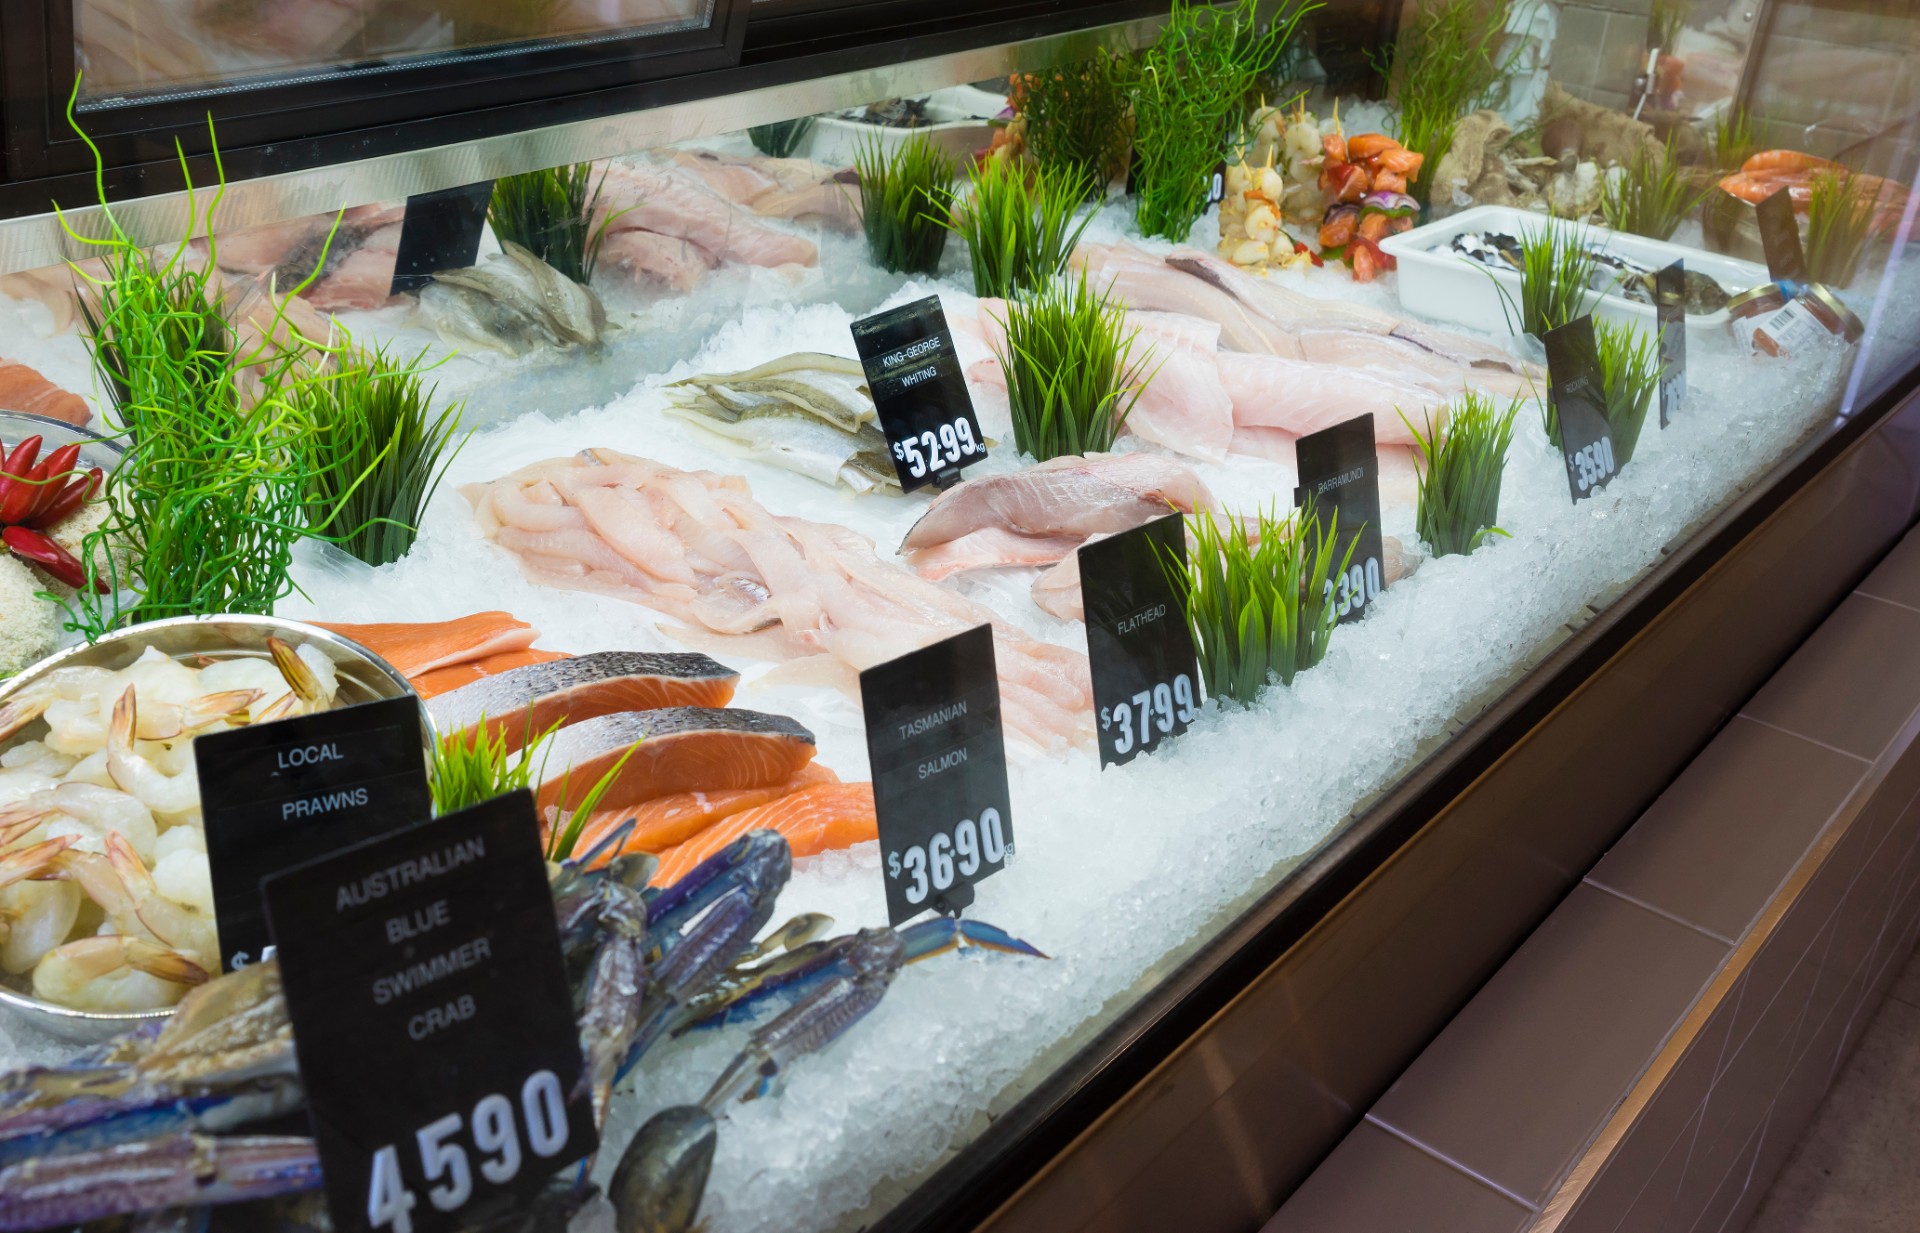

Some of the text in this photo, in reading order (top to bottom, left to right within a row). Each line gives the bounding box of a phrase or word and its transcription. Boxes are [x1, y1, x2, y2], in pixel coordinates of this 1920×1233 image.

[883, 337, 941, 367] KING-GEORGE
[901, 366, 937, 388] WHITING
[1317, 467, 1364, 494] BARRAMUNDI
[1117, 603, 1166, 636] FLATHEAD
[899, 700, 968, 740] TASMANIAN
[277, 742, 344, 770] LOCAL
[918, 748, 968, 780] SALMON
[282, 788, 369, 822] PRAWNS
[336, 836, 486, 913] AUSTRALIAN
[385, 902, 451, 945] BLUE
[371, 937, 491, 1006] SWIMMER
[407, 994, 476, 1042] CRAB
[367, 1069, 570, 1233] 4590
